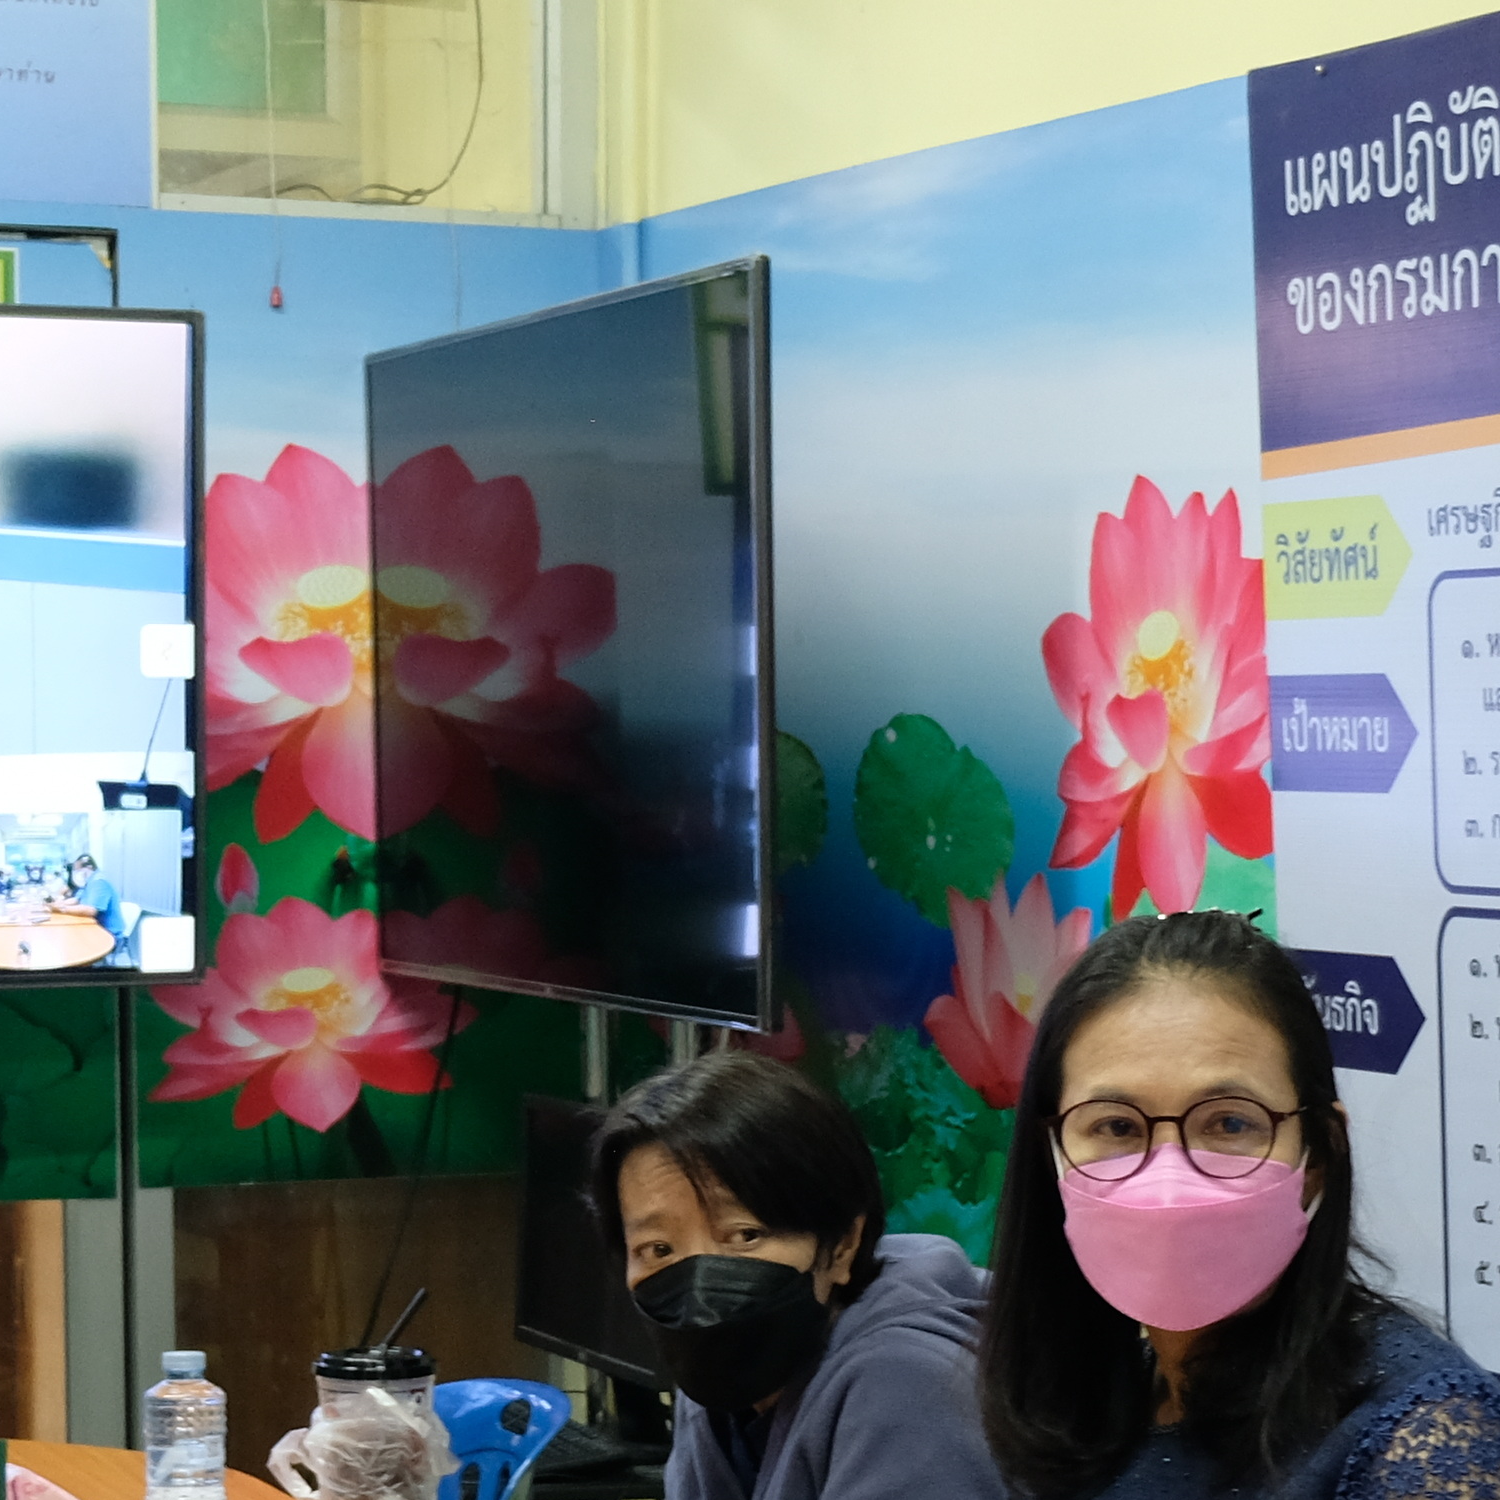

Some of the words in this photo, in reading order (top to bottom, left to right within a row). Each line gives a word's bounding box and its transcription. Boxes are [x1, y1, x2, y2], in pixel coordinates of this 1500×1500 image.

[1276, 523, 1380, 585] วิสัยทัศน์
[1281, 697, 1390, 753] เป้าหมาย
[1301, 974, 1379, 1036] ันธกิจ
